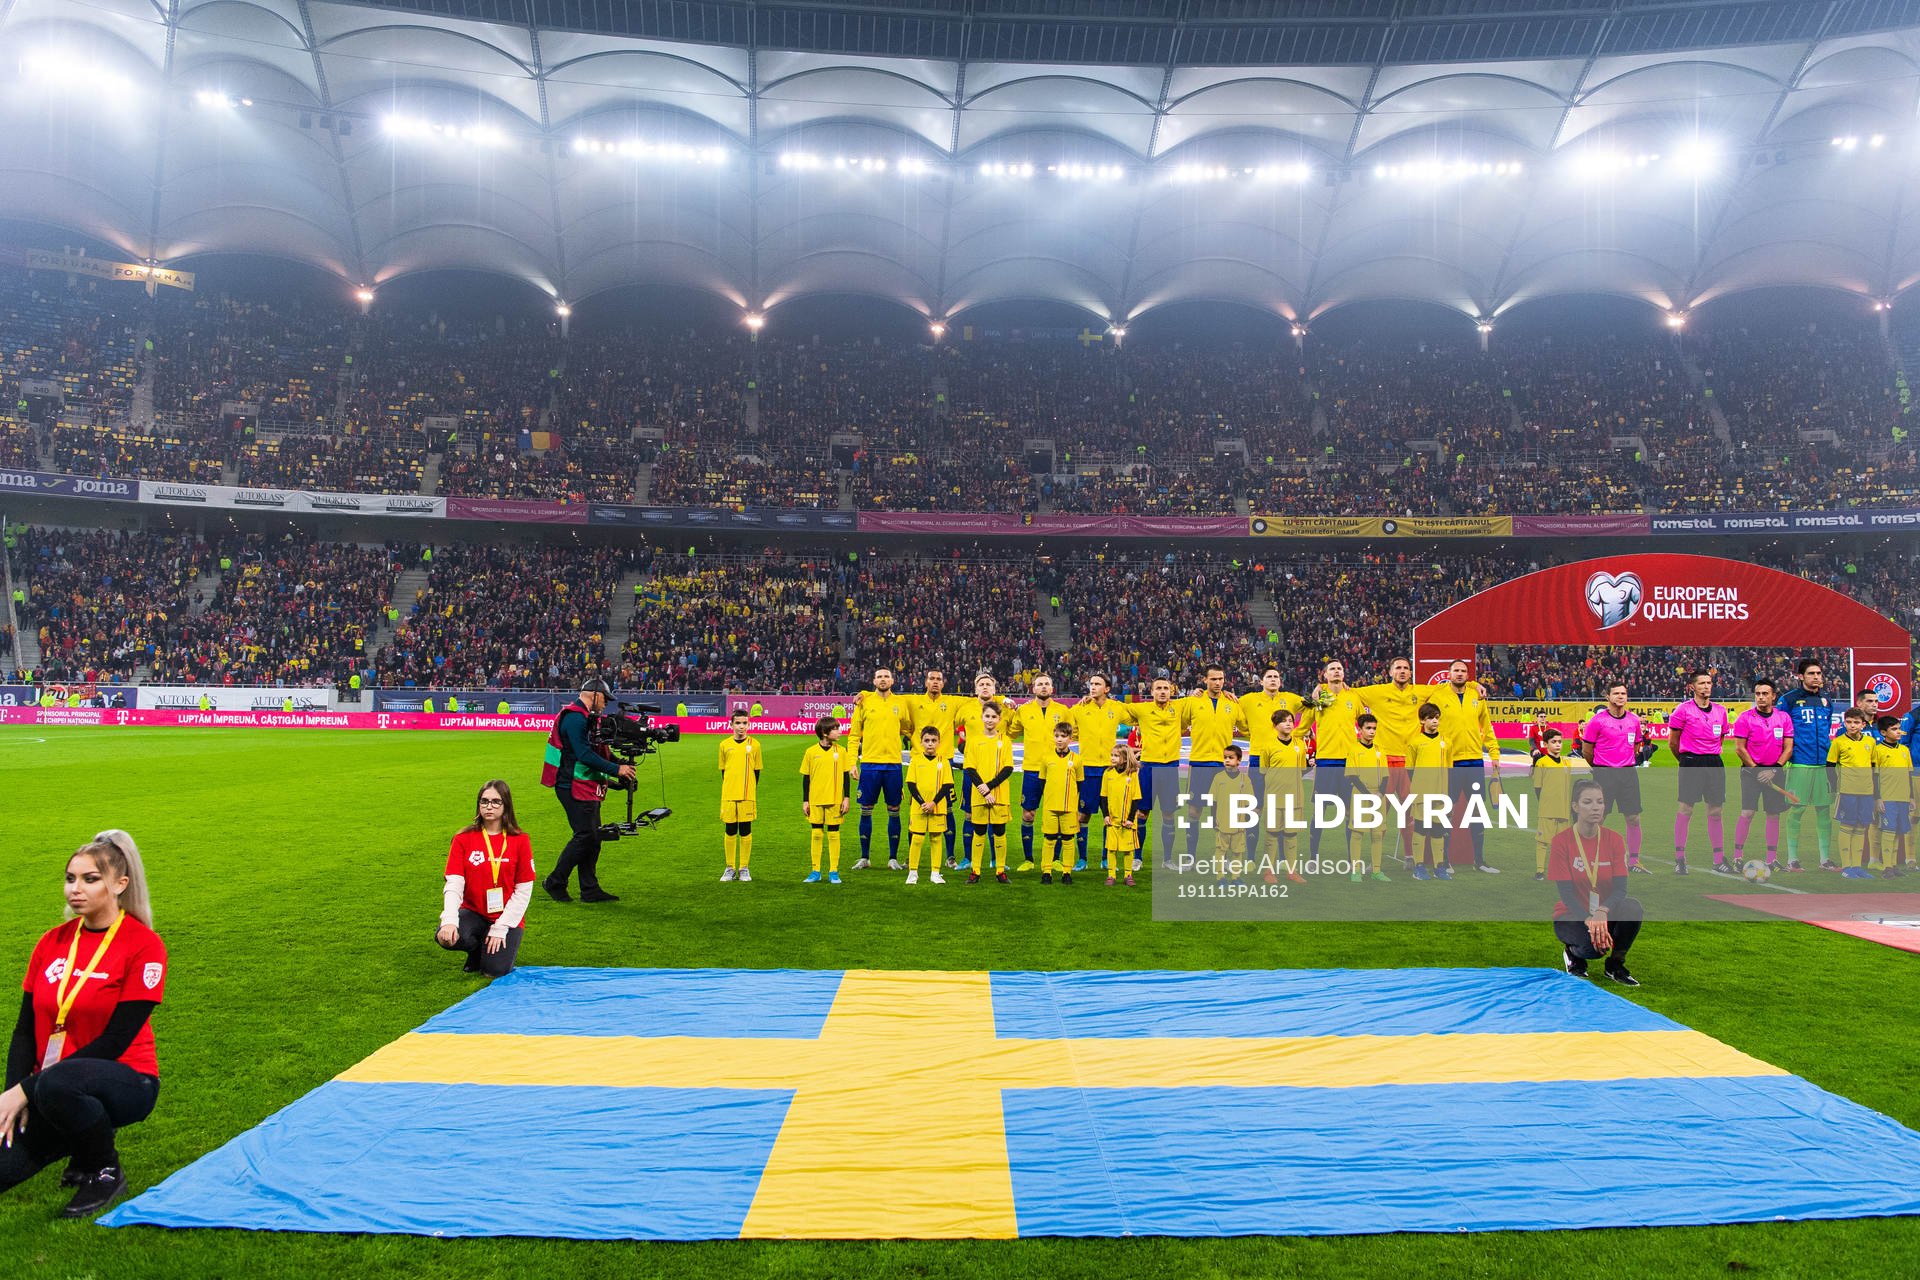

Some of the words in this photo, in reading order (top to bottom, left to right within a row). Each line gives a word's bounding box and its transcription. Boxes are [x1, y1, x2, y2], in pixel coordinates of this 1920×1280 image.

[114, 268, 183, 283] FORUNA
[0, 473, 37, 487] ma
[1654, 586, 1738, 601] EUROPEAN
[1643, 603, 1749, 621] QUALIFIERS
[1872, 676, 1893, 685] UEFA
[251, 697, 312, 706] AUTOKASS
[178, 714, 211, 724] LUPTĂM
[305, 715, 348, 725] ÎMPREUNĂ
[440, 717, 473, 727] LUPTĂM
[524, 717, 554, 729] CÂȘTIG
[706, 720, 732, 730] LUPTĂ
[749, 720, 788, 732] PREUNĂ,
